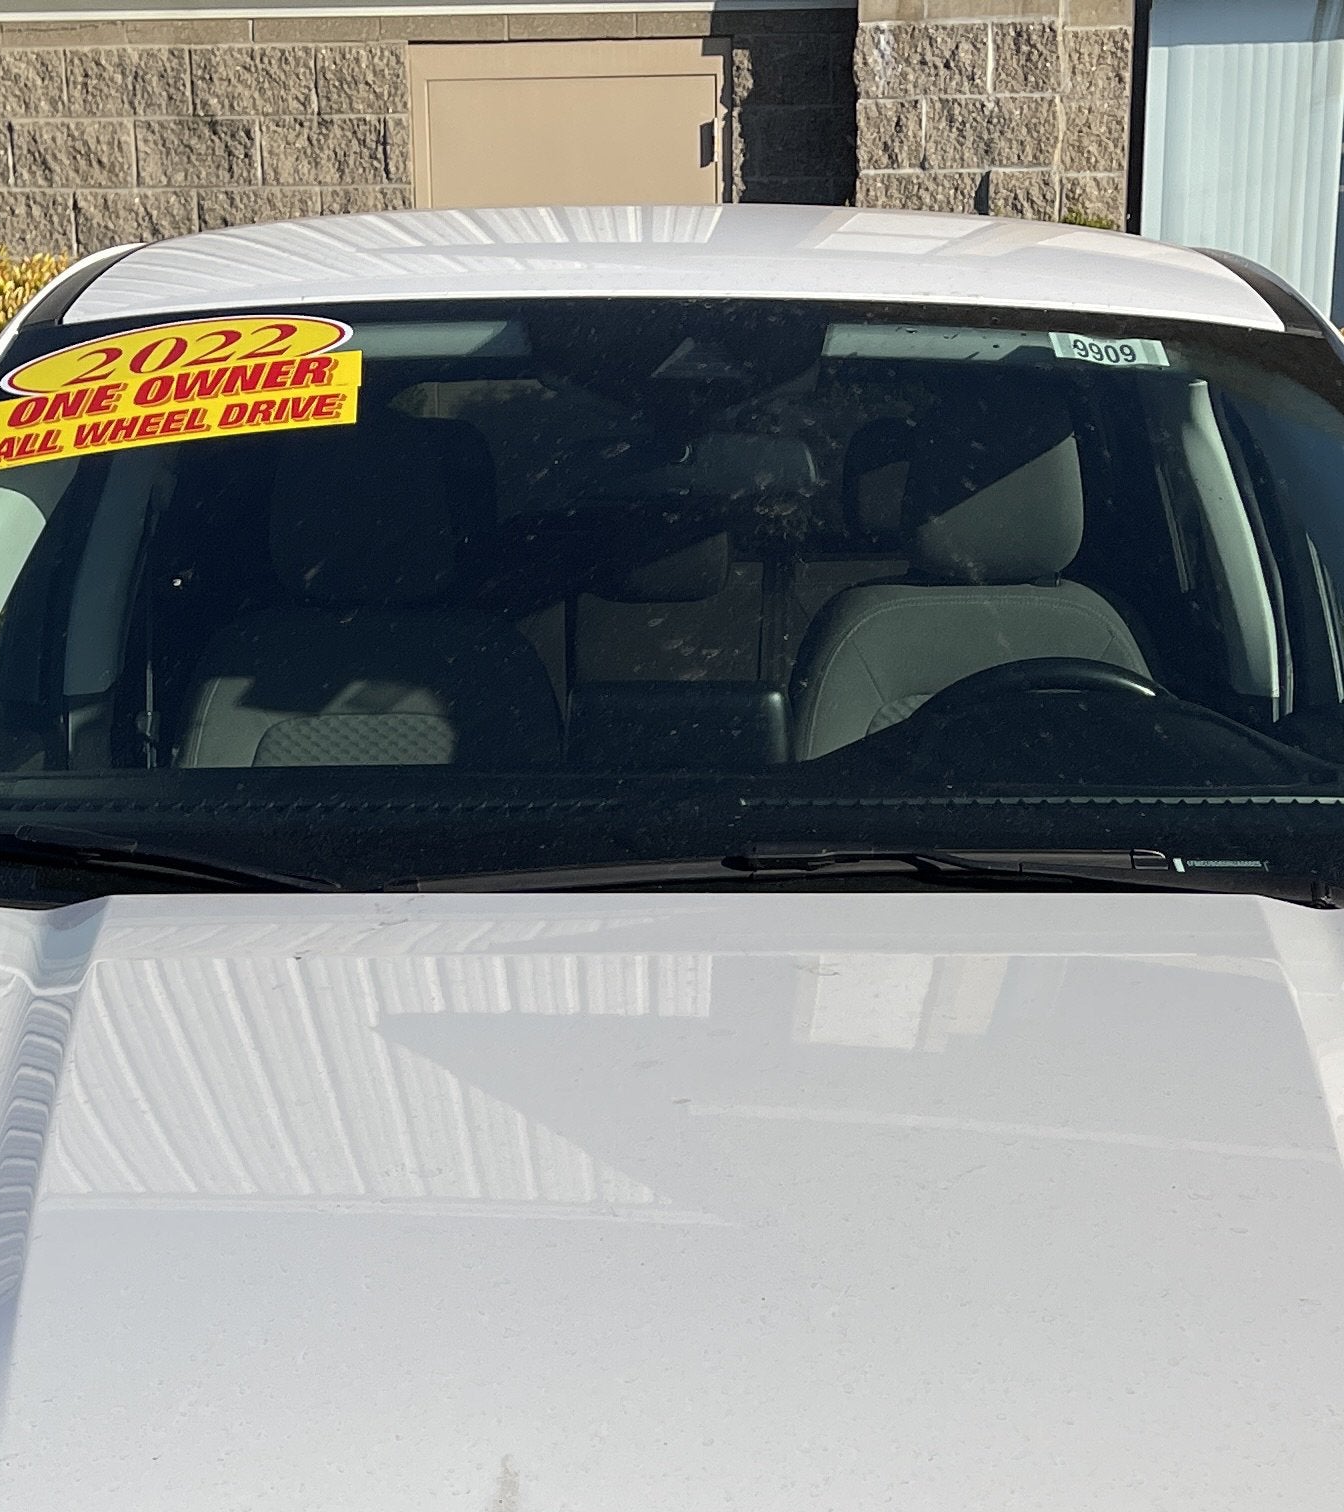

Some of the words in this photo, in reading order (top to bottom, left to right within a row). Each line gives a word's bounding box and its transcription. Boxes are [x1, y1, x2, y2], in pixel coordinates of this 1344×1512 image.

[62, 323, 298, 387] 2022
[1072, 339, 1137, 364] 9909
[7, 383, 128, 429] ONE
[133, 356, 340, 408] OWNER
[74, 408, 212, 449] WHEEL
[217, 392, 347, 429] DRIVE
